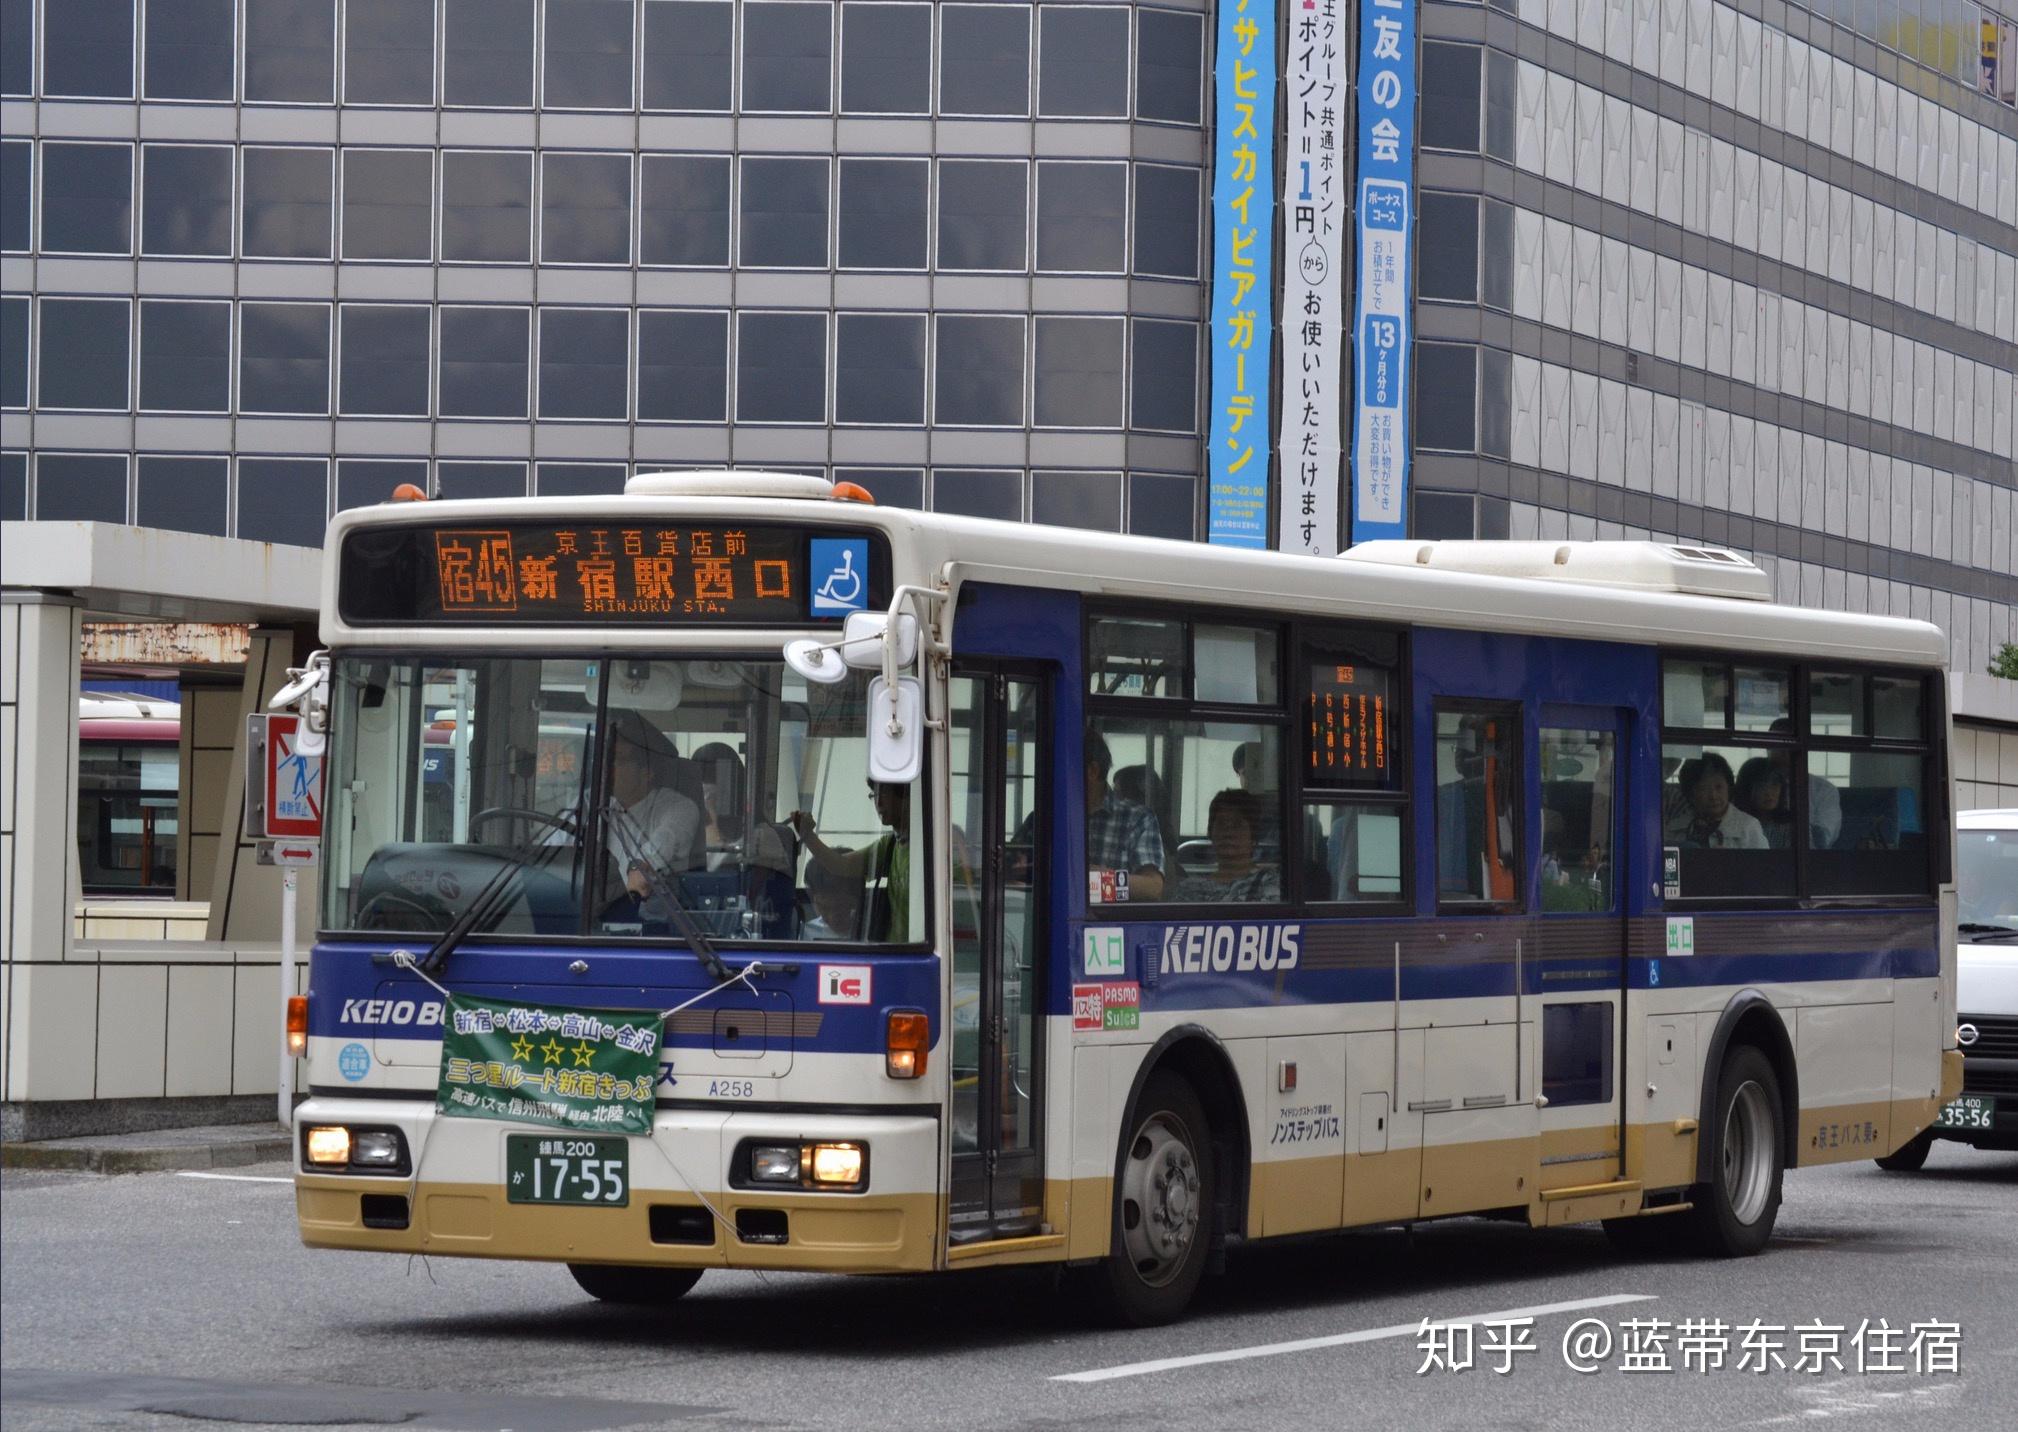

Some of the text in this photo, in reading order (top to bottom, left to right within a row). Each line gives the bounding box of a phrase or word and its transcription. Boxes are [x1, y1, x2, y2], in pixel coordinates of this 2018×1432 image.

[1372, 0, 1402, 163] 友の会
[1296, 0, 1318, 234] ポイント=1円
[1368, 191, 1401, 207] ボーナス
[1373, 209, 1397, 223] コース
[1227, 0, 1259, 474] サヒスカイビアガーデン
[1303, 258, 1324, 272] から
[1300, 290, 1322, 555] お使いいただけます。
[555, 530, 747, 556] 京王百貨店前
[441, 538, 515, 604] 宿45
[519, 554, 790, 601] 新宿駅西口
[583, 600, 726, 613] SHINJUKU STA.
[1668, 923, 1692, 949] 出口
[1087, 935, 1125, 968] 入口
[1074, 993, 1101, 1022] バス特
[1105, 986, 1137, 1002] PASMO
[340, 999, 416, 1024] KEIO
[1106, 1010, 1137, 1027] Suica
[453, 1008, 656, 1056] 新宿 松本 高山 金沢
[446, 1058, 654, 1103] 三つ星ルート新宿きっぷ
[709, 1081, 753, 1098] A258
[1271, 1117, 1339, 1144] ノンステップバス
[1945, 1108, 1990, 1127] 35-56
[512, 1157, 623, 1201] か 17-55
